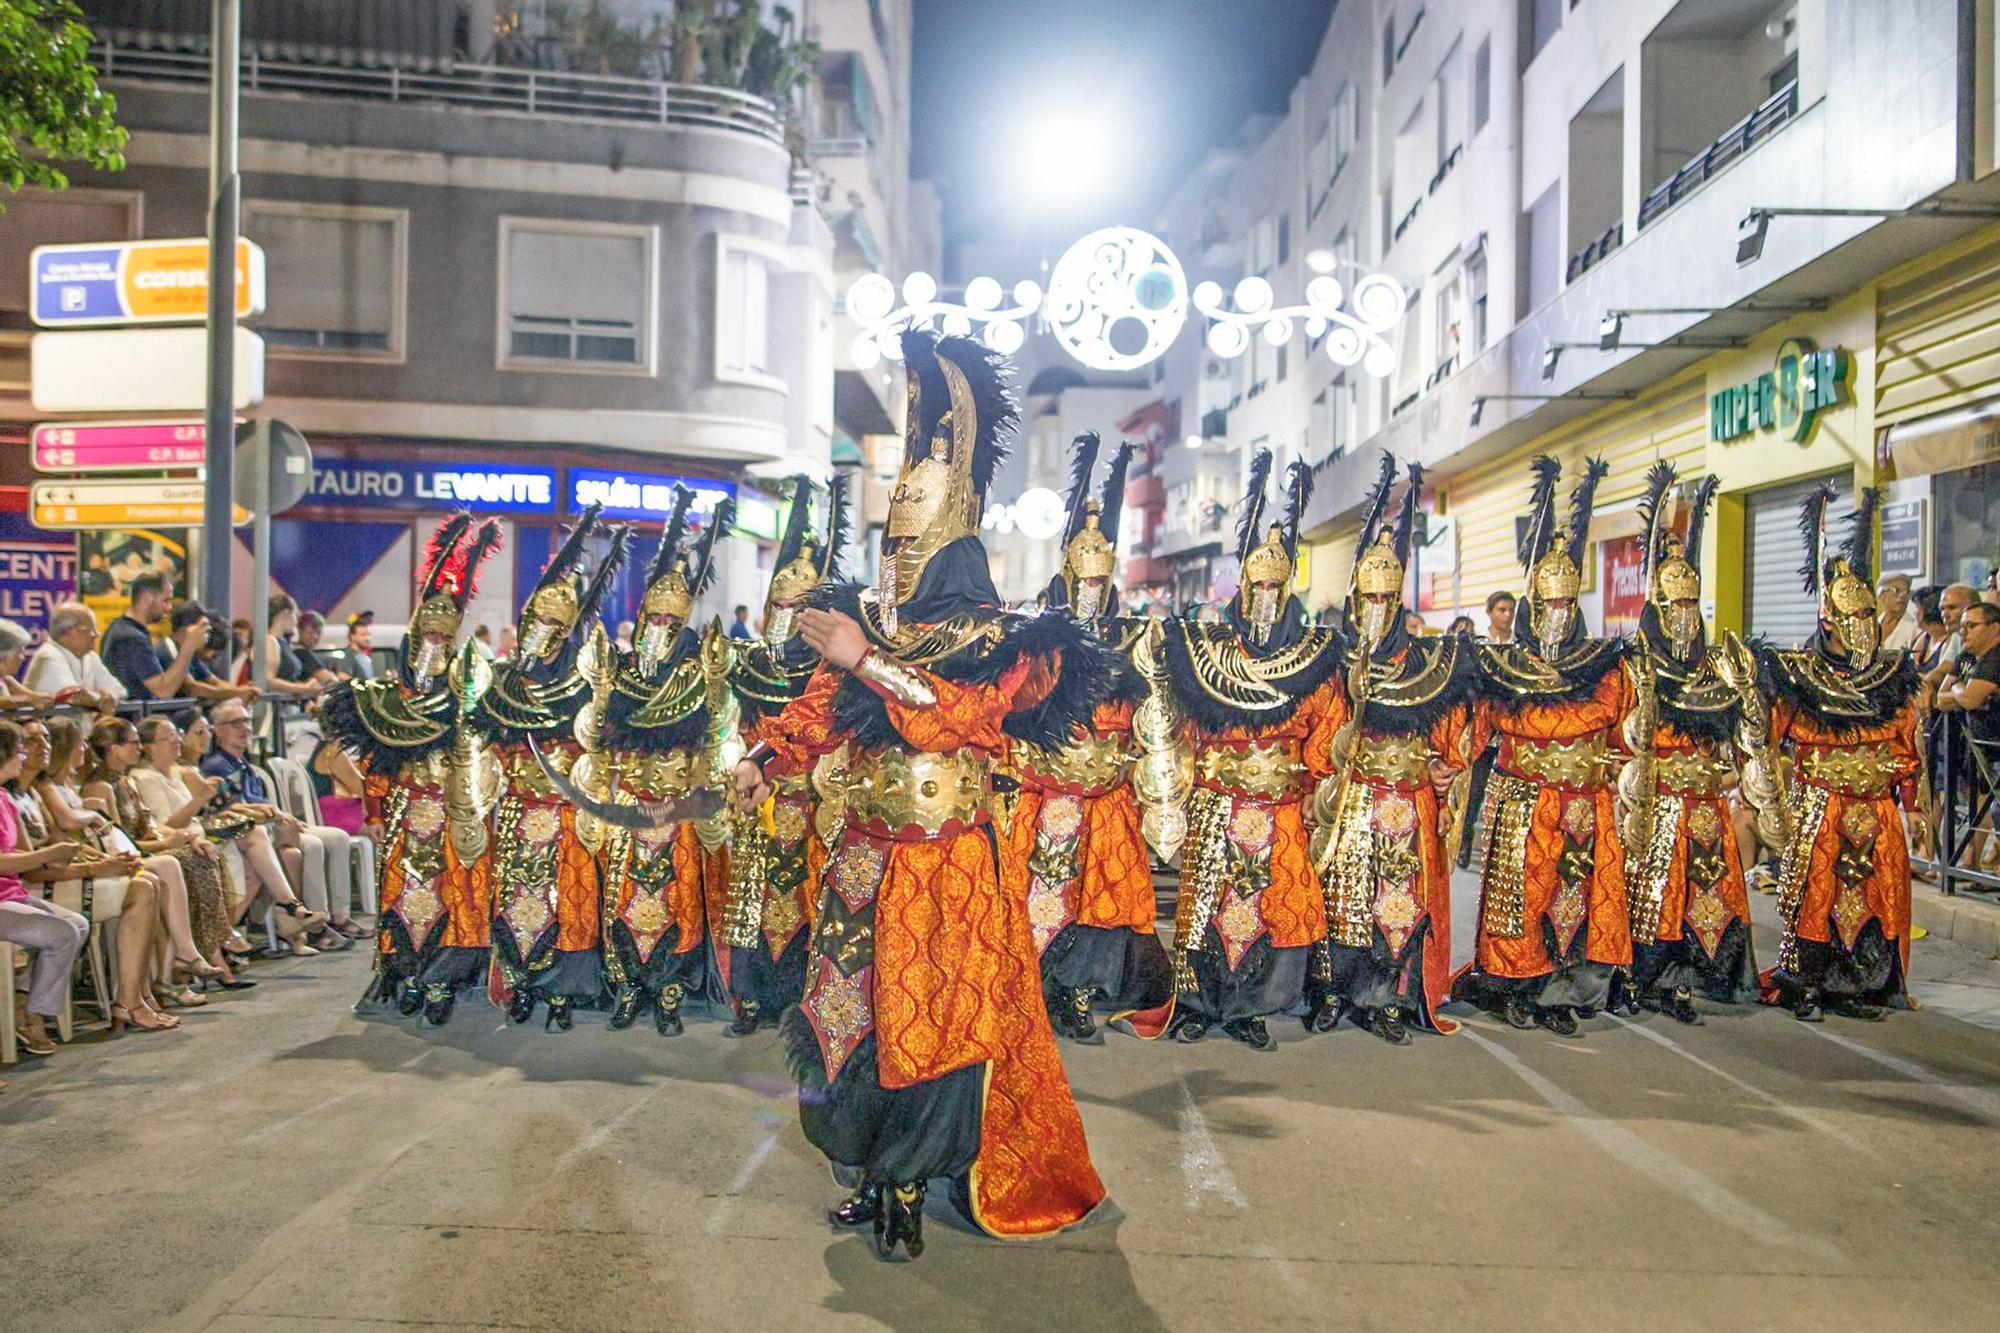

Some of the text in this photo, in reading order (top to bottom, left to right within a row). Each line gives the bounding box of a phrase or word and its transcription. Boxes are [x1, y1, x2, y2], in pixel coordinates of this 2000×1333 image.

[134, 269, 243, 289] consu
[162, 489, 206, 500] Guardi
[416, 473, 551, 504] LEVANTE
[3, 589, 77, 617] LEV
